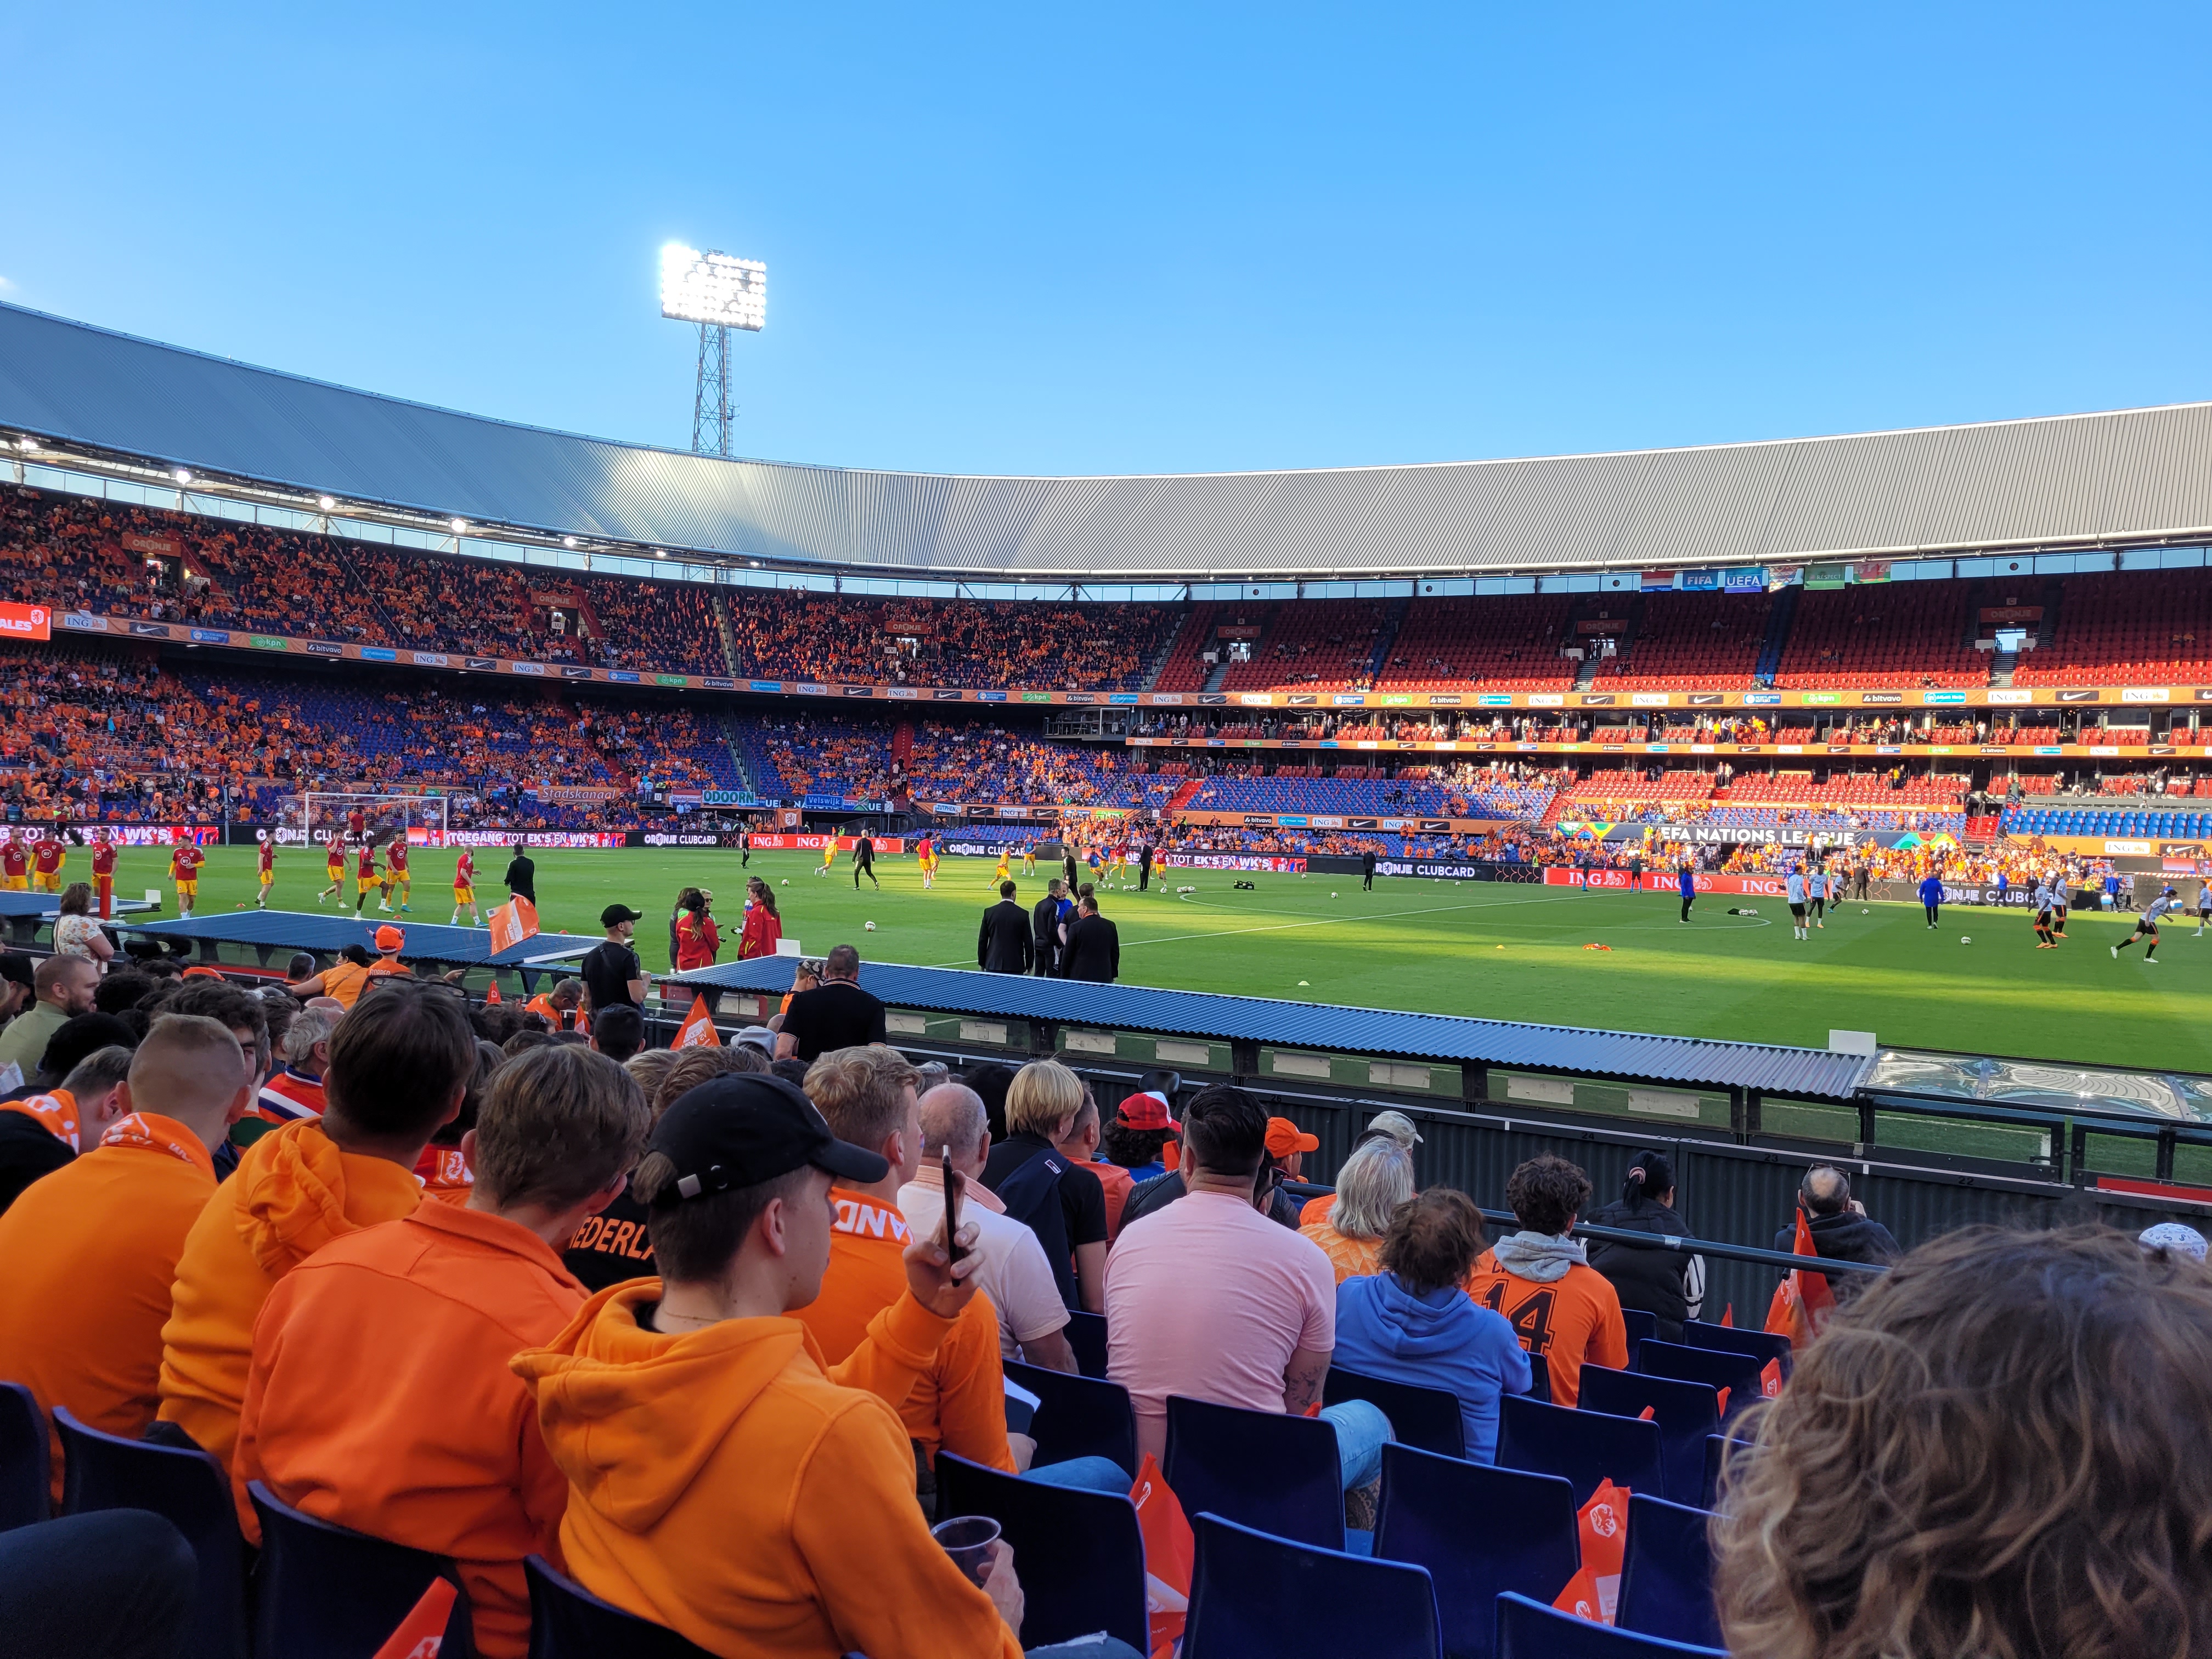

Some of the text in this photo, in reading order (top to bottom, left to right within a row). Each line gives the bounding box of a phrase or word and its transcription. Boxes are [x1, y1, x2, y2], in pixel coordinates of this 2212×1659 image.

[1688, 576, 1712, 585] FIFA
[1727, 576, 1760, 585] UEFA
[67, 617, 89, 628] ING
[317, 645, 341, 653] bitvavo
[416, 655, 433, 663] ING
[515, 664, 531, 673] ING
[669, 676, 682, 685] kpn
[1818, 694, 1835, 702] kpn
[1872, 694, 1901, 702] bitvavo
[1991, 693, 2012, 702] ING
[2125, 692, 2148, 700] ING
[543, 787, 616, 800] Stadskanaal
[703, 790, 754, 803] ODOORN
[809, 797, 840, 805] Velswijk
[125, 828, 168, 840] WK'S
[256, 827, 374, 844] ONJE CLUCRD
[449, 832, 596, 843] TOEGANG TOT EK'S EN WK'S
[1661, 827, 1691, 840] EFA
[1696, 827, 1775, 843] NATIONS
[680, 835, 717, 844] CLUBCARD
[754, 837, 771, 846] ING
[797, 837, 820, 847] ING
[988, 846, 1025, 856] CLUCAR
[1171, 855, 1270, 867] TOT EK'S EN WK'S
[1375, 862, 1475, 877] RNJE CLUBCARD
[1569, 872, 1602, 885] ING
[1741, 880, 1779, 893] ING
[1271, 1094, 1282, 1103] 26
[1424, 1111, 1436, 1120] 25
[1582, 1132, 1594, 1140] 24
[1765, 1154, 1778, 1162] 23
[1958, 1176, 1974, 1186] 22
[569, 1216, 654, 1260] EDERL
[1482, 1279, 1558, 1355] 14
